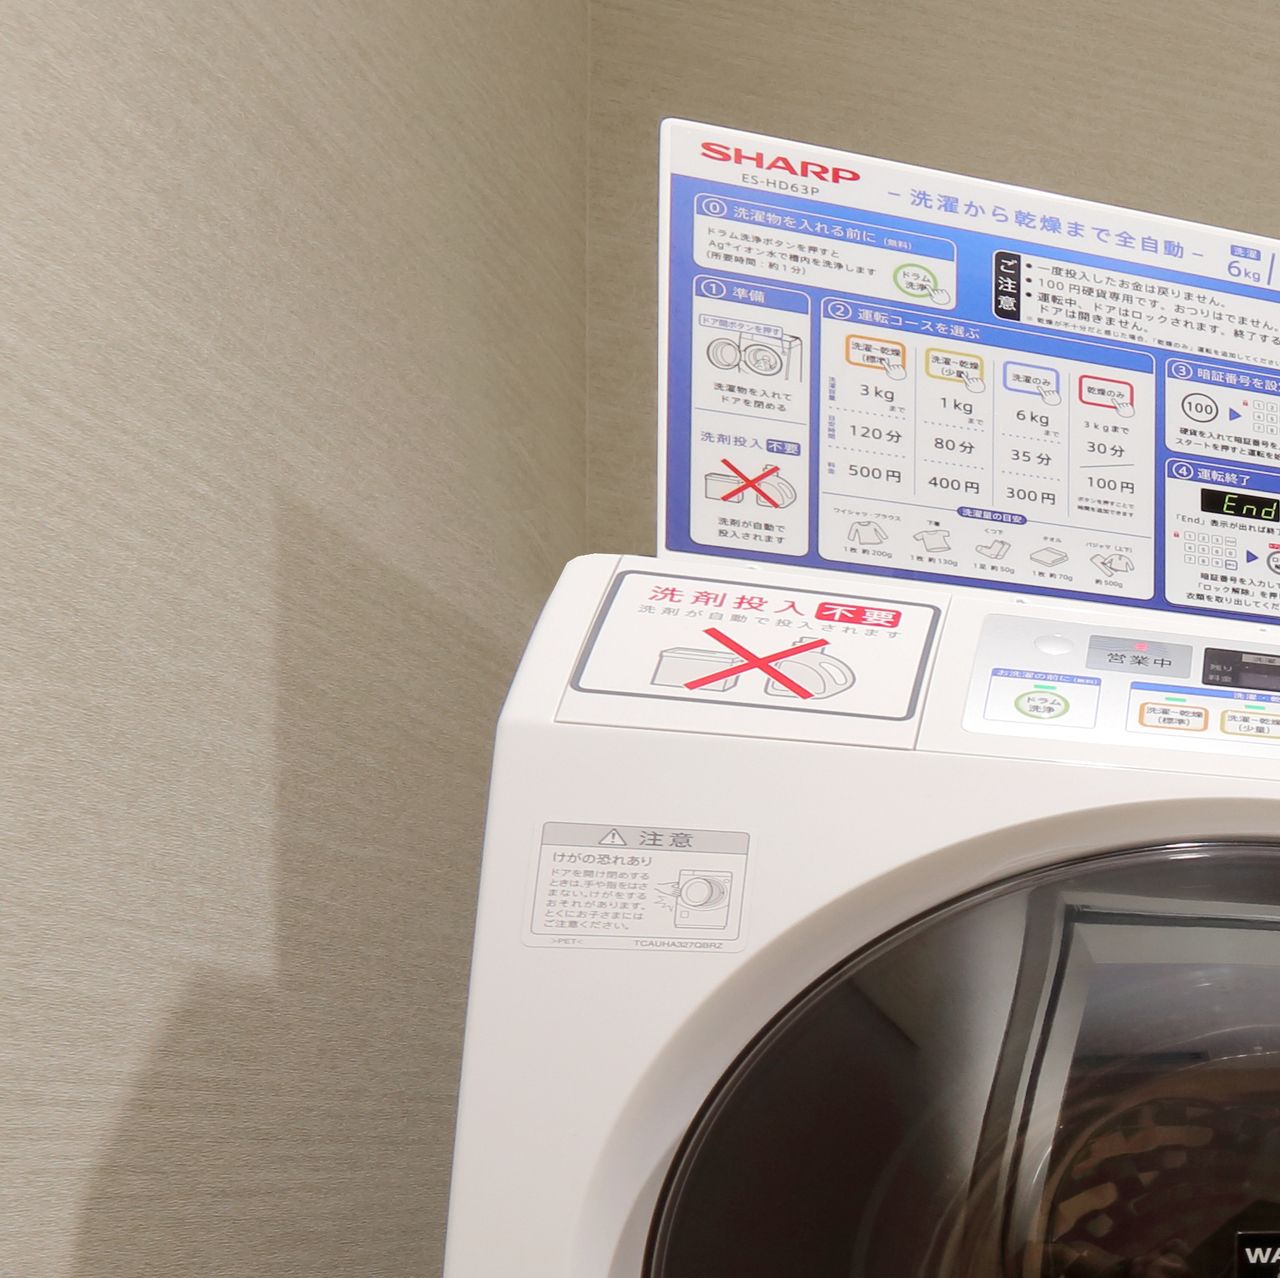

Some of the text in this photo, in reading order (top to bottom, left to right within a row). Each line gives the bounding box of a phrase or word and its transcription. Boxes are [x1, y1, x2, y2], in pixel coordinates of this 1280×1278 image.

[701, 142, 860, 183] SHARP
[741, 173, 819, 196] ES-HD63P
[733, 205, 877, 243] 洗濯物を入れる前に
[910, 187, 1186, 261] 洗濯から乾燥まで全自動
[707, 227, 840, 259] ドラム洗浄ボタンを押すと
[1227, 261, 1260, 283] 6kg
[732, 287, 765, 304] 準備
[998, 259, 1017, 311] ご注意
[1037, 263, 1227, 308] 一度投入したお金は戻りません。
[858, 306, 981, 339] 運転コースを選ぶ
[1040, 305, 1148, 333] ドアは開きません。
[1012, 372, 1052, 387] 洗濯のみ
[714, 382, 792, 401] 洗濯物を入れて
[1087, 386, 1125, 400] 乾燥のみ
[721, 396, 786, 412] ドアを閉める
[1187, 402, 1213, 414] 100
[700, 431, 800, 454] 洗剤投入 不要
[1197, 468, 1251, 486] 運転終了
[1223, 494, 1278, 519] End
[718, 516, 785, 534] 洗剤が自動で
[718, 529, 785, 545] 投入されます
[649, 585, 895, 626] 洗剤投入 不要
[637, 604, 904, 638] 洗剤が自動で投入されます
[1107, 653, 1172, 668] 営業中
[639, 830, 693, 848] 注意
[552, 852, 653, 866] けがの恐れあり
